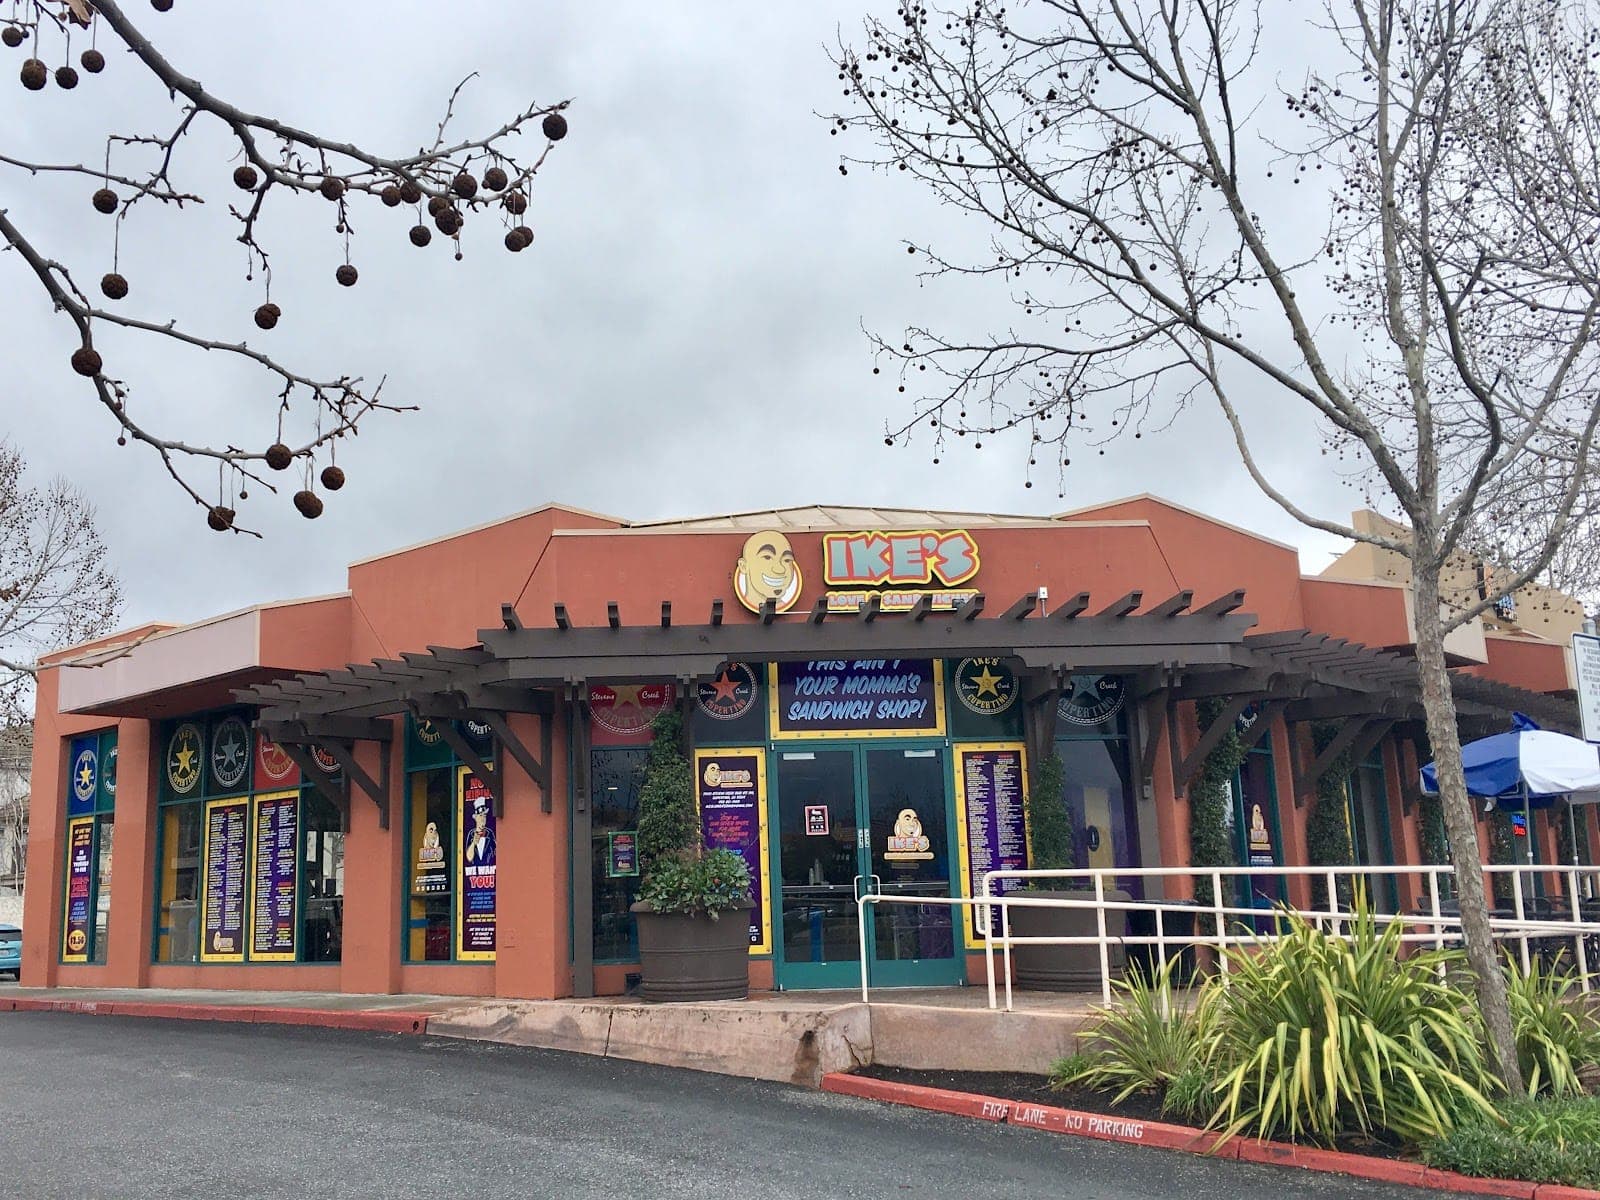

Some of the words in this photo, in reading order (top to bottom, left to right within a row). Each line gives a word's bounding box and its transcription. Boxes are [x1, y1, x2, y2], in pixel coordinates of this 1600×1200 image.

[829, 535, 974, 579] IKE'S
[829, 594, 864, 606] LOVE
[794, 675, 839, 696] YOUR
[841, 672, 921, 695] MOMMA'S
[704, 698, 747, 715] CUPERTINO
[787, 699, 874, 721] SANDWICH
[876, 698, 928, 719] SHOP!
[967, 693, 1009, 708] CUPERTINO
[1058, 697, 1115, 717] CUPERTINO
[889, 836, 930, 851] IKE'S
[470, 875, 495, 888] YOU!
[982, 1102, 1009, 1118] FIRE
[1015, 1106, 1048, 1125] LANE
[1065, 1114, 1082, 1129] NO
[1088, 1118, 1144, 1138] PARKING
